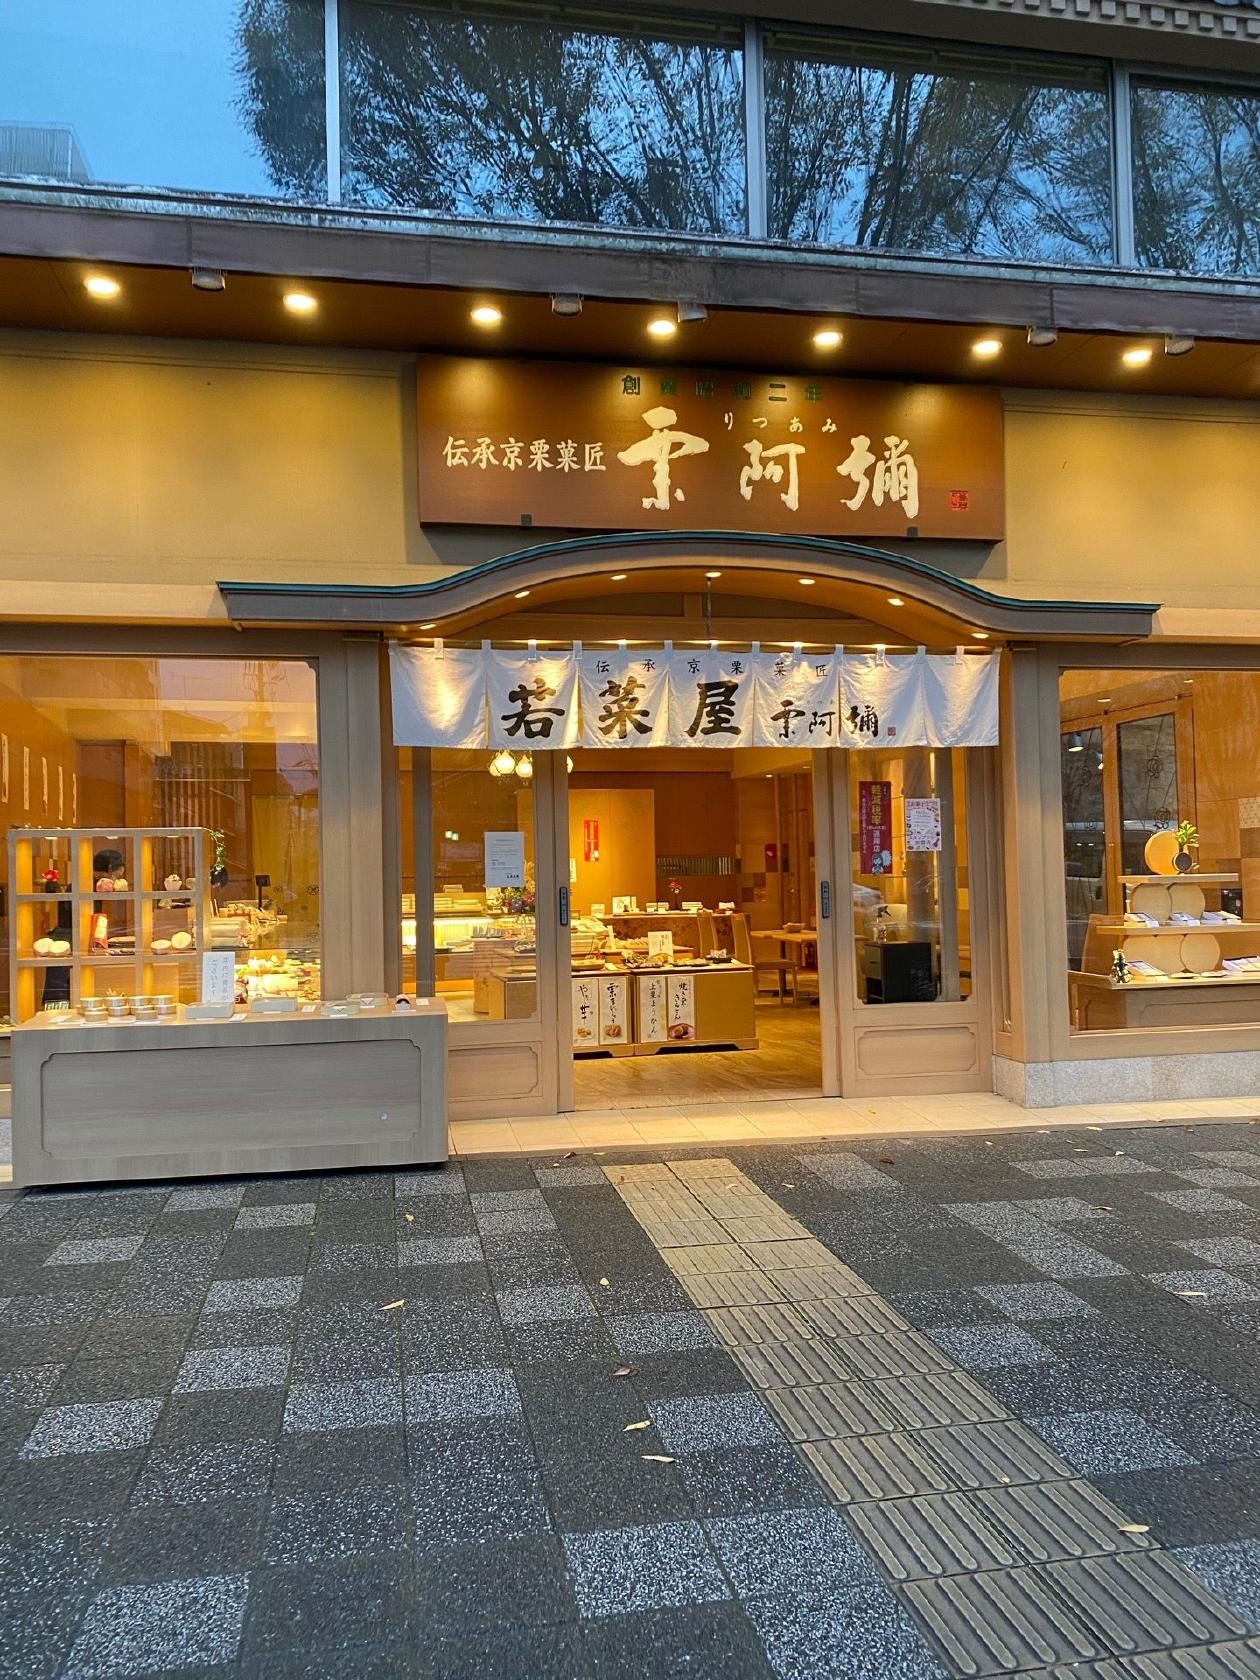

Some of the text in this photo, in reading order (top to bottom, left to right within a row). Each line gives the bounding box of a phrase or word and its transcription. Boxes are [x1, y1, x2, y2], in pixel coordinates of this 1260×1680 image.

[724, 412, 837, 433] りつあみ
[443, 436, 606, 473] 伝承京栗菓匠
[501, 677, 741, 739] 若菜屋
